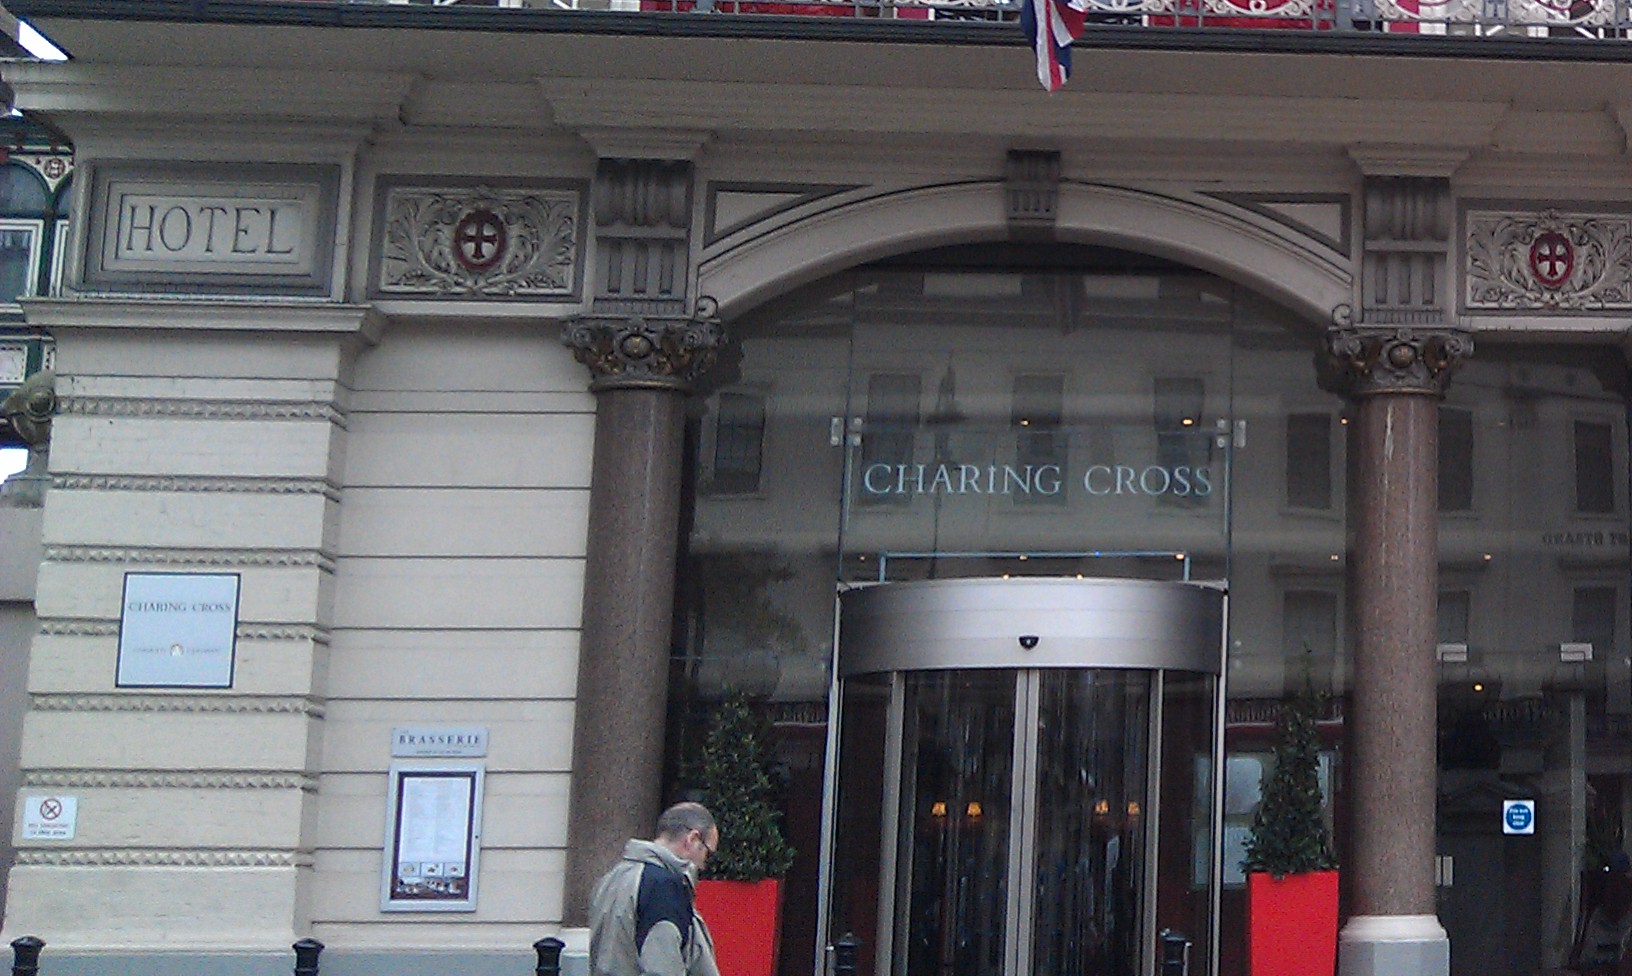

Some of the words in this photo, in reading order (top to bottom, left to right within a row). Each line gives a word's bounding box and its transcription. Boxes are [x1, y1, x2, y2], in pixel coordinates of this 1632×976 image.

[126, 204, 295, 254] HOTEL
[864, 463, 1062, 496] CHARING
[1083, 464, 1213, 497] CROSS
[128, 602, 187, 612] CHARING
[192, 602, 232, 612] CROSS
[399, 735, 479, 745] BRASSERIE
